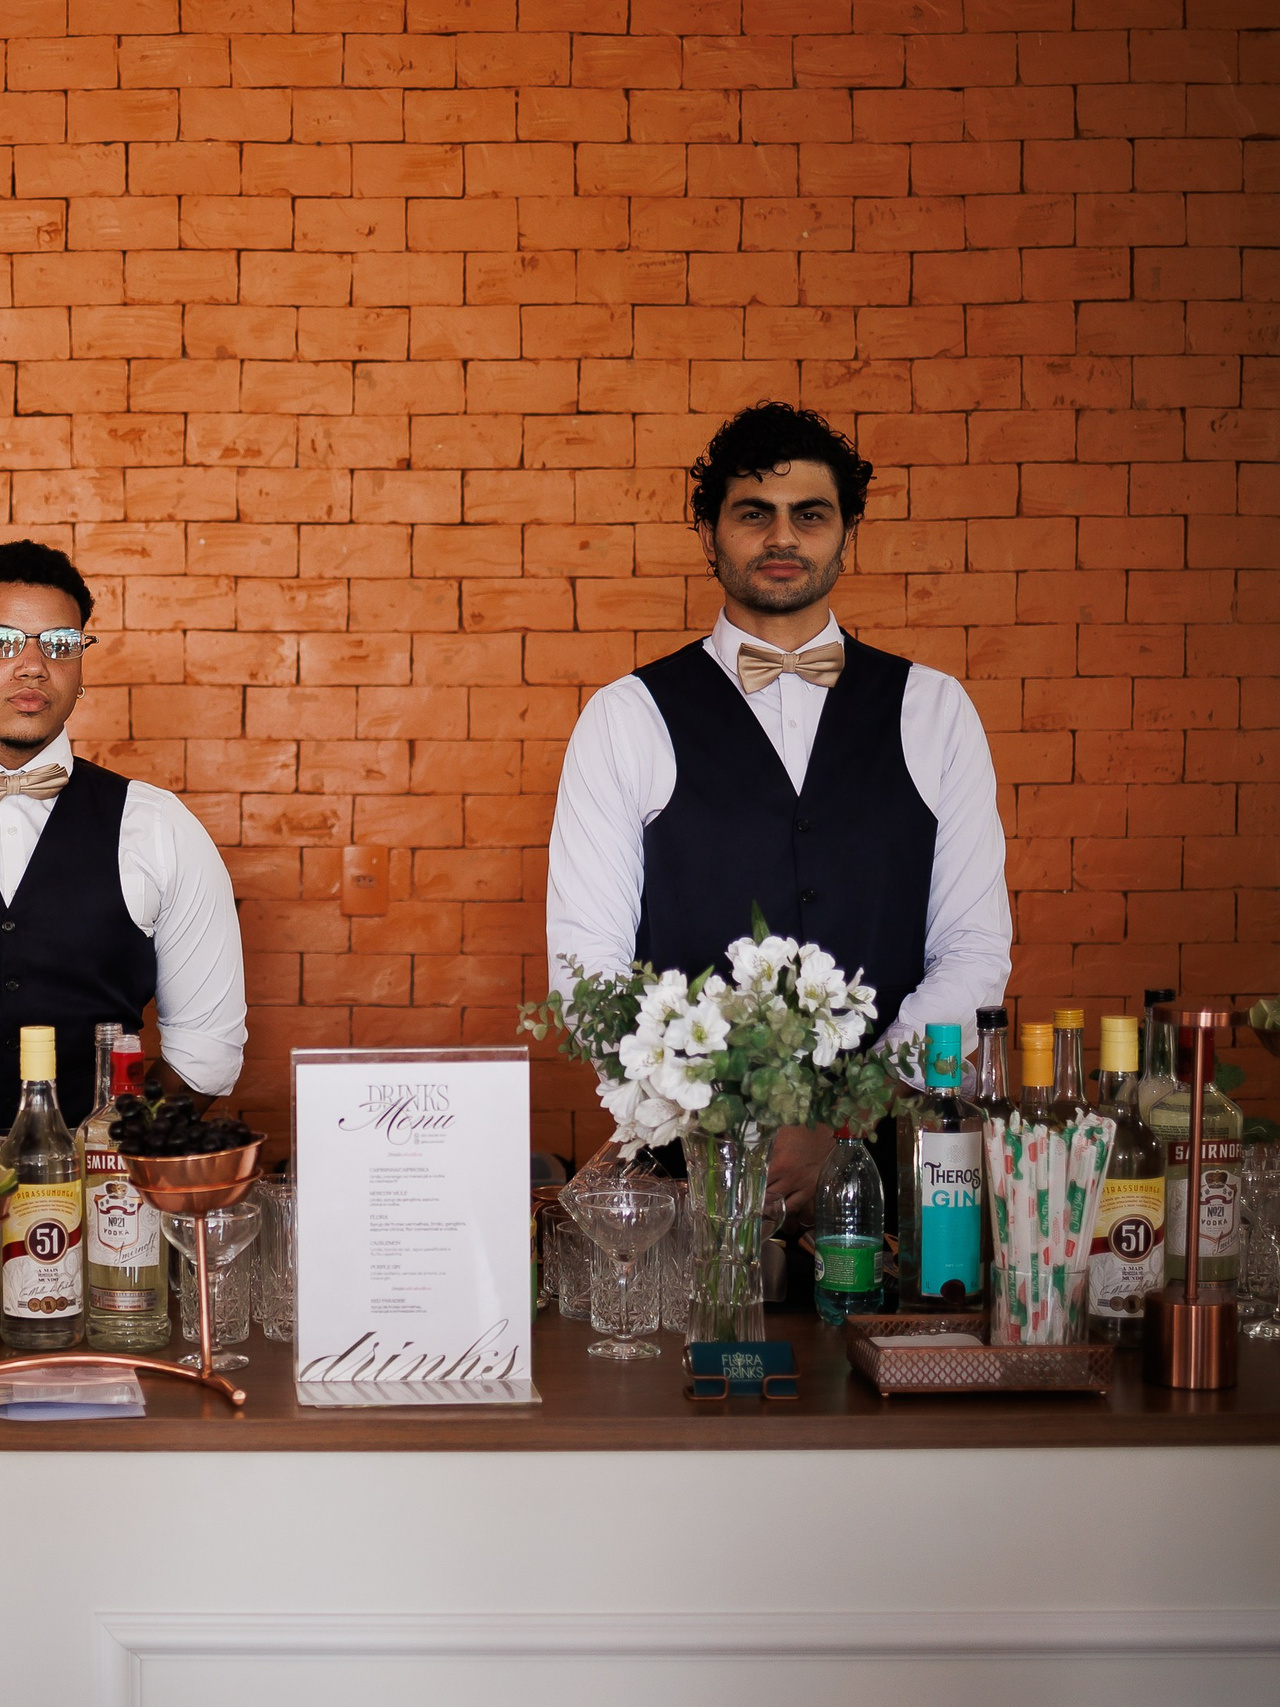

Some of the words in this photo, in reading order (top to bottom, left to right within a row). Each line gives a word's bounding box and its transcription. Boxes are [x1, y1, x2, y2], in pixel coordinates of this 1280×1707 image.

[367, 1085, 450, 1112] DRINKS
[1175, 1144, 1242, 1160] SIRNOF
[87, 1155, 127, 1170] SMIRN
[924, 1162, 980, 1189] THEROS
[931, 1189, 976, 1208] GIN
[1201, 1219, 1228, 1227] VODKA
[103, 1228, 129, 1236] VODKA
[1121, 1225, 1144, 1252] 51
[36, 1228, 58, 1254] 51
[300, 1319, 524, 1382] drinks
[721, 1352, 763, 1367] FLORA
[723, 1367, 764, 1379] DRINKS
